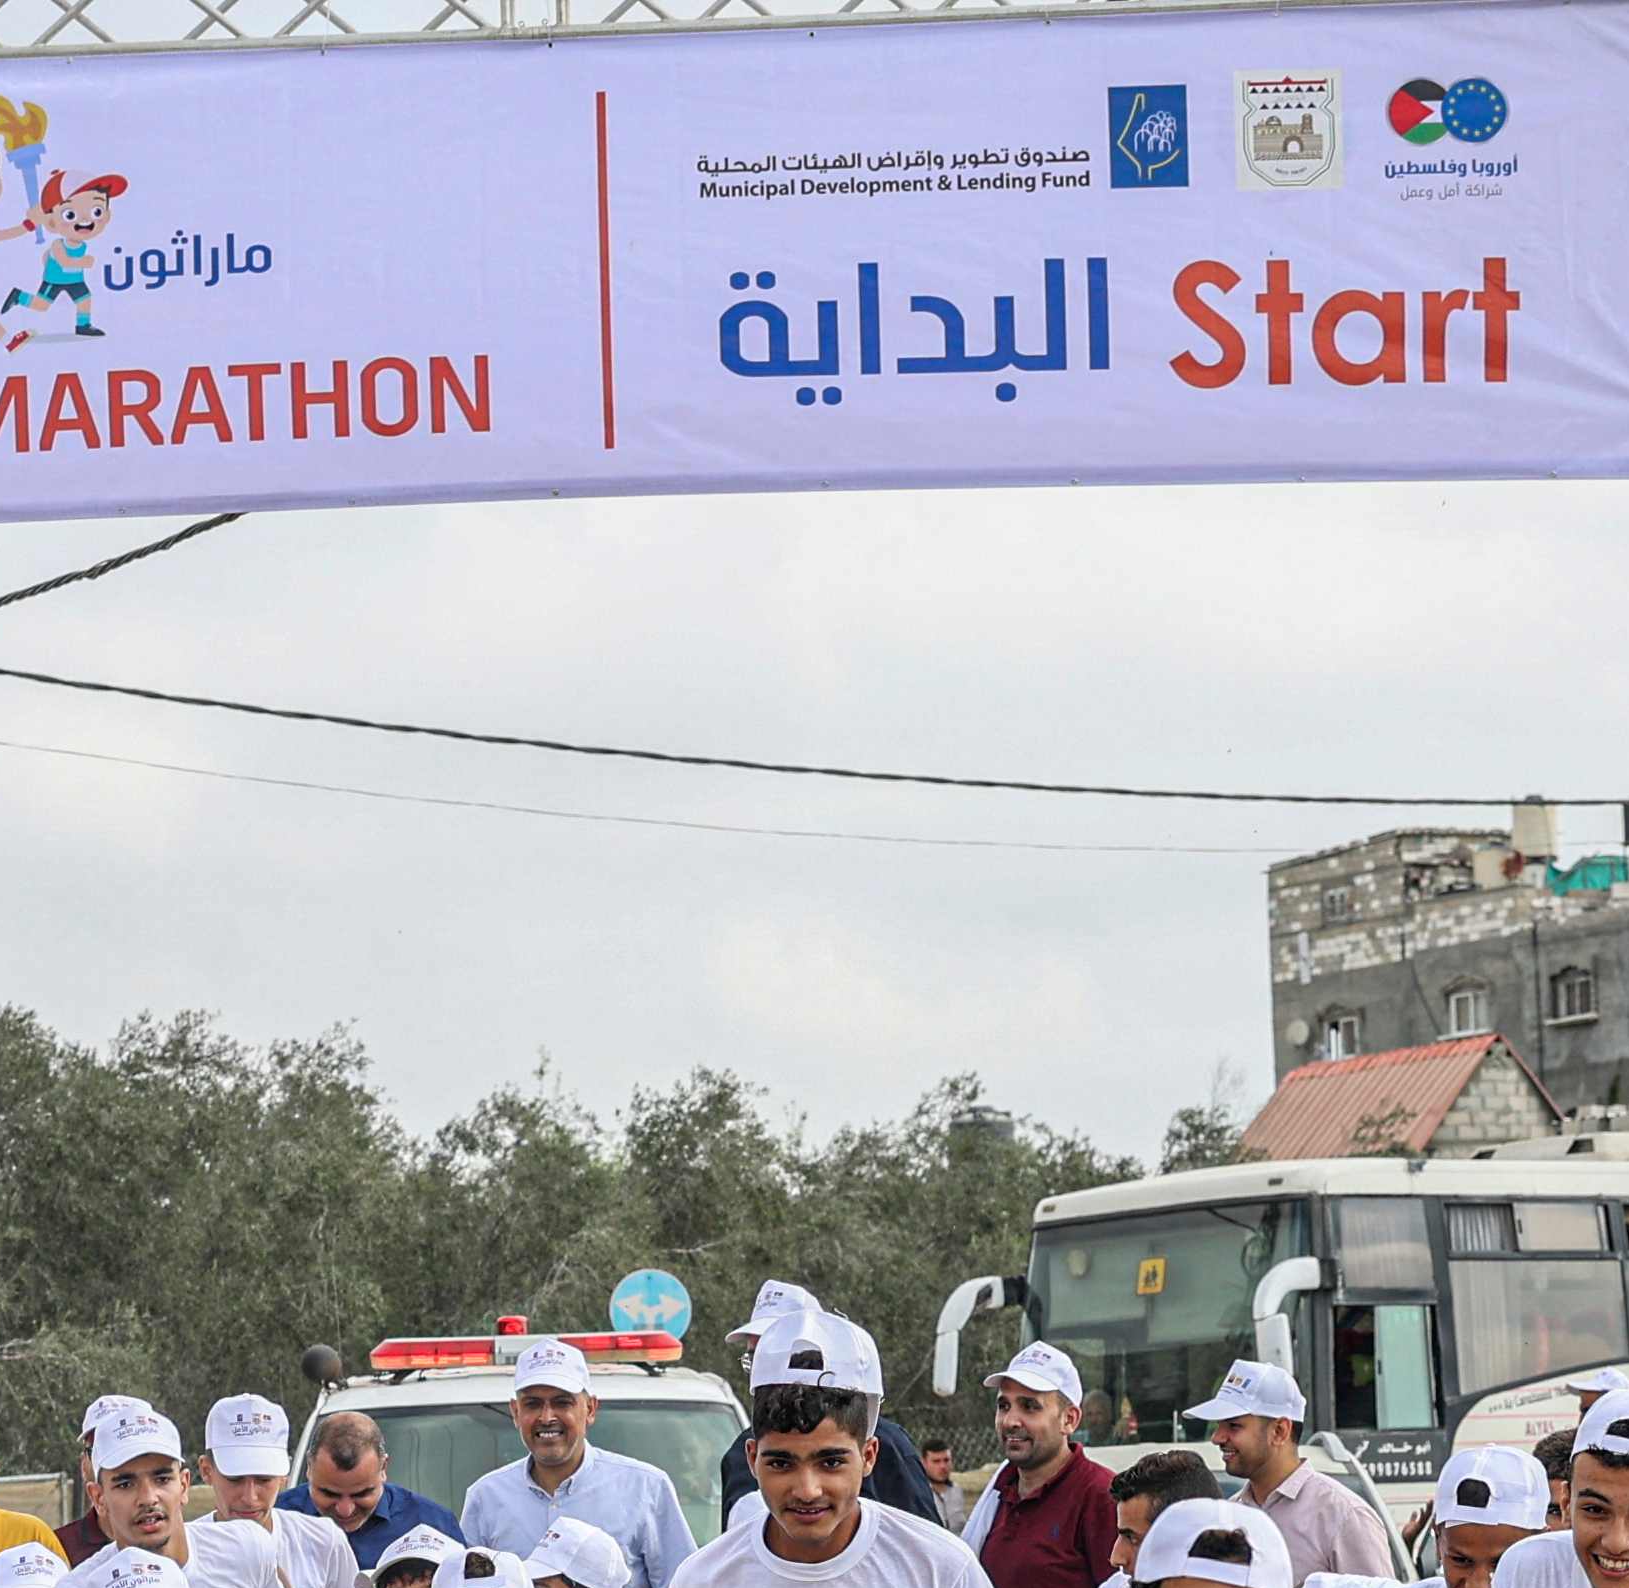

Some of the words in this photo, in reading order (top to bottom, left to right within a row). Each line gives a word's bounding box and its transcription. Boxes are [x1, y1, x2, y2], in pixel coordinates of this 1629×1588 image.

[696, 154, 778, 176] المحلية
[781, 152, 862, 172] الهيئات
[866, 149, 945, 173] وإقراض
[950, 147, 1011, 170] تطوير
[1014, 147, 1091, 167] صندوق
[1472, 154, 1518, 176] أوروبا
[1384, 158, 1469, 179] وفلسطين
[699, 177, 796, 200] Municipal
[801, 174, 933, 199] Development
[937, 175, 952, 191] &
[957, 171, 1037, 194] Lending
[1041, 170, 1091, 188] Fund
[1399, 186, 1434, 202] وعمل
[1438, 183, 1460, 200] أمل
[1465, 184, 1503, 198] شراكة
[102, 232, 273, 292] ماراثون
[718, 256, 1111, 407] البداية
[1168, 256, 1522, 390] Start
